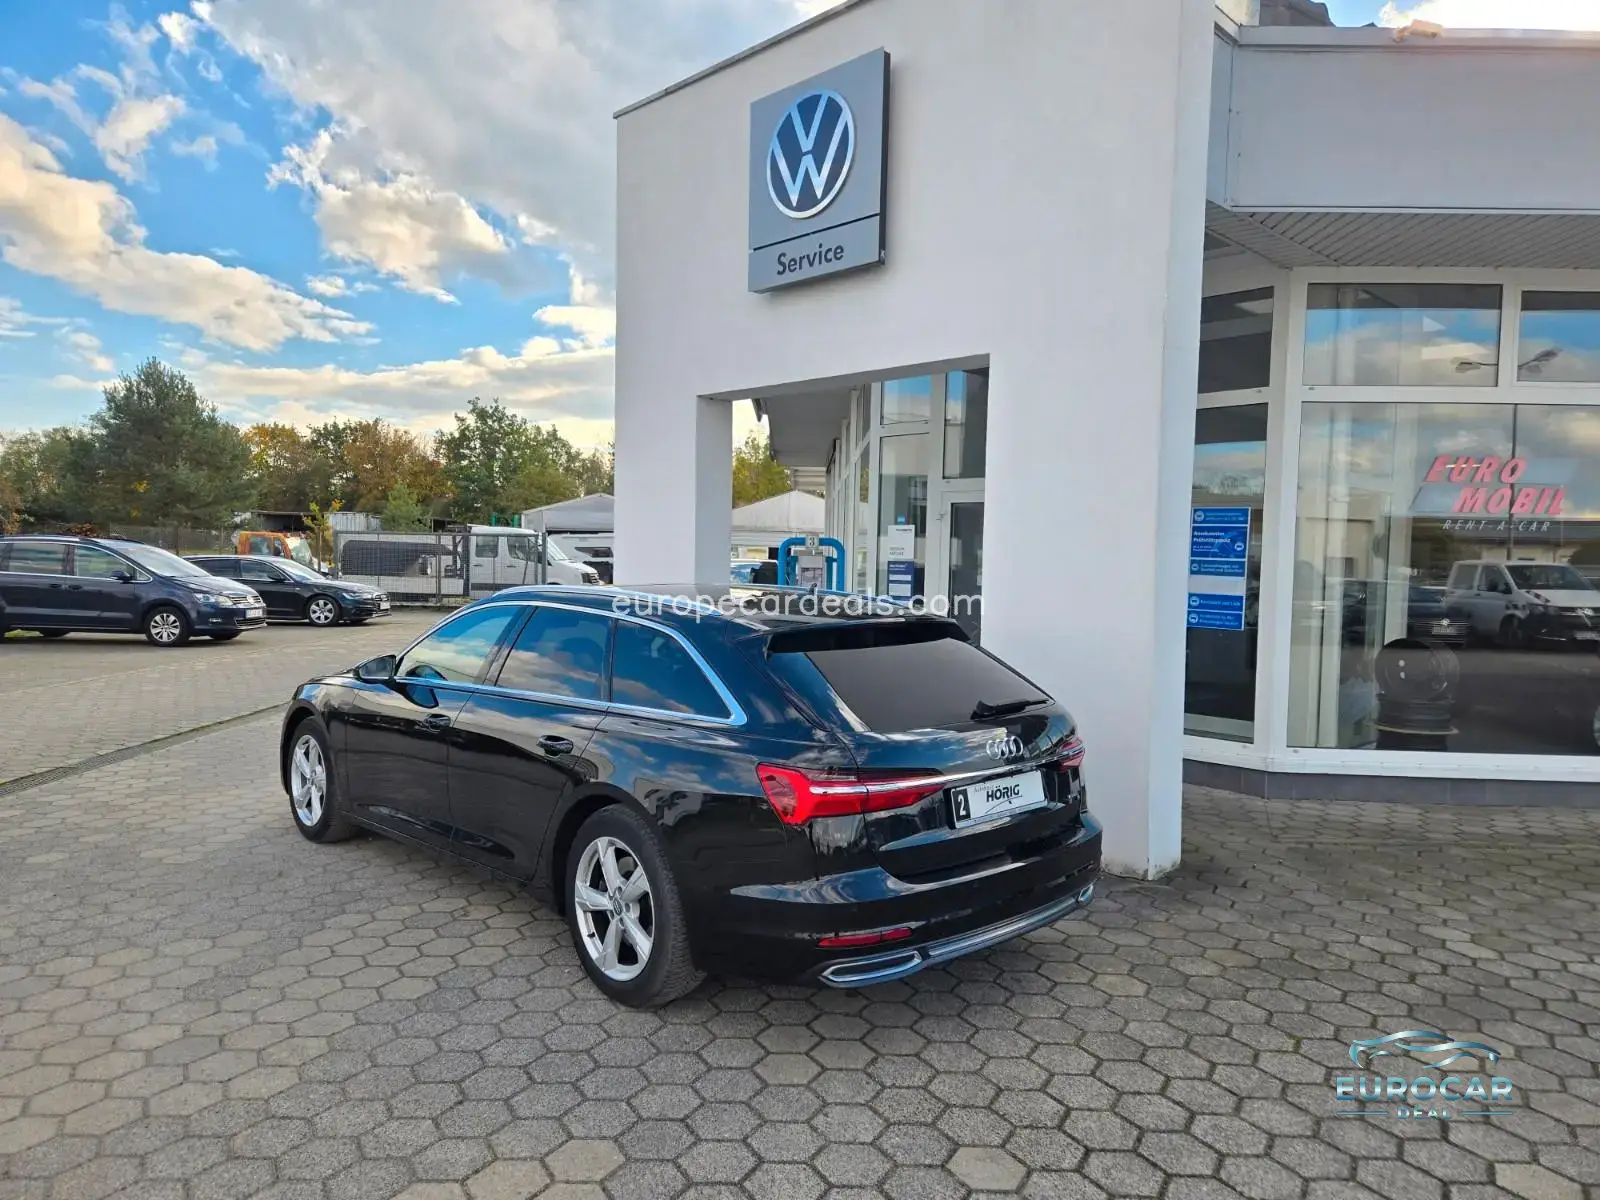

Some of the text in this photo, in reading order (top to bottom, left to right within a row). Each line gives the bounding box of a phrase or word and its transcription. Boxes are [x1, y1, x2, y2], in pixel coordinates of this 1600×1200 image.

[777, 243, 845, 276] Service
[1424, 455, 1528, 484] EURO
[1452, 487, 1568, 515] MOBIL
[957, 794, 967, 816] 2
[986, 783, 1020, 803] HÖRIG
